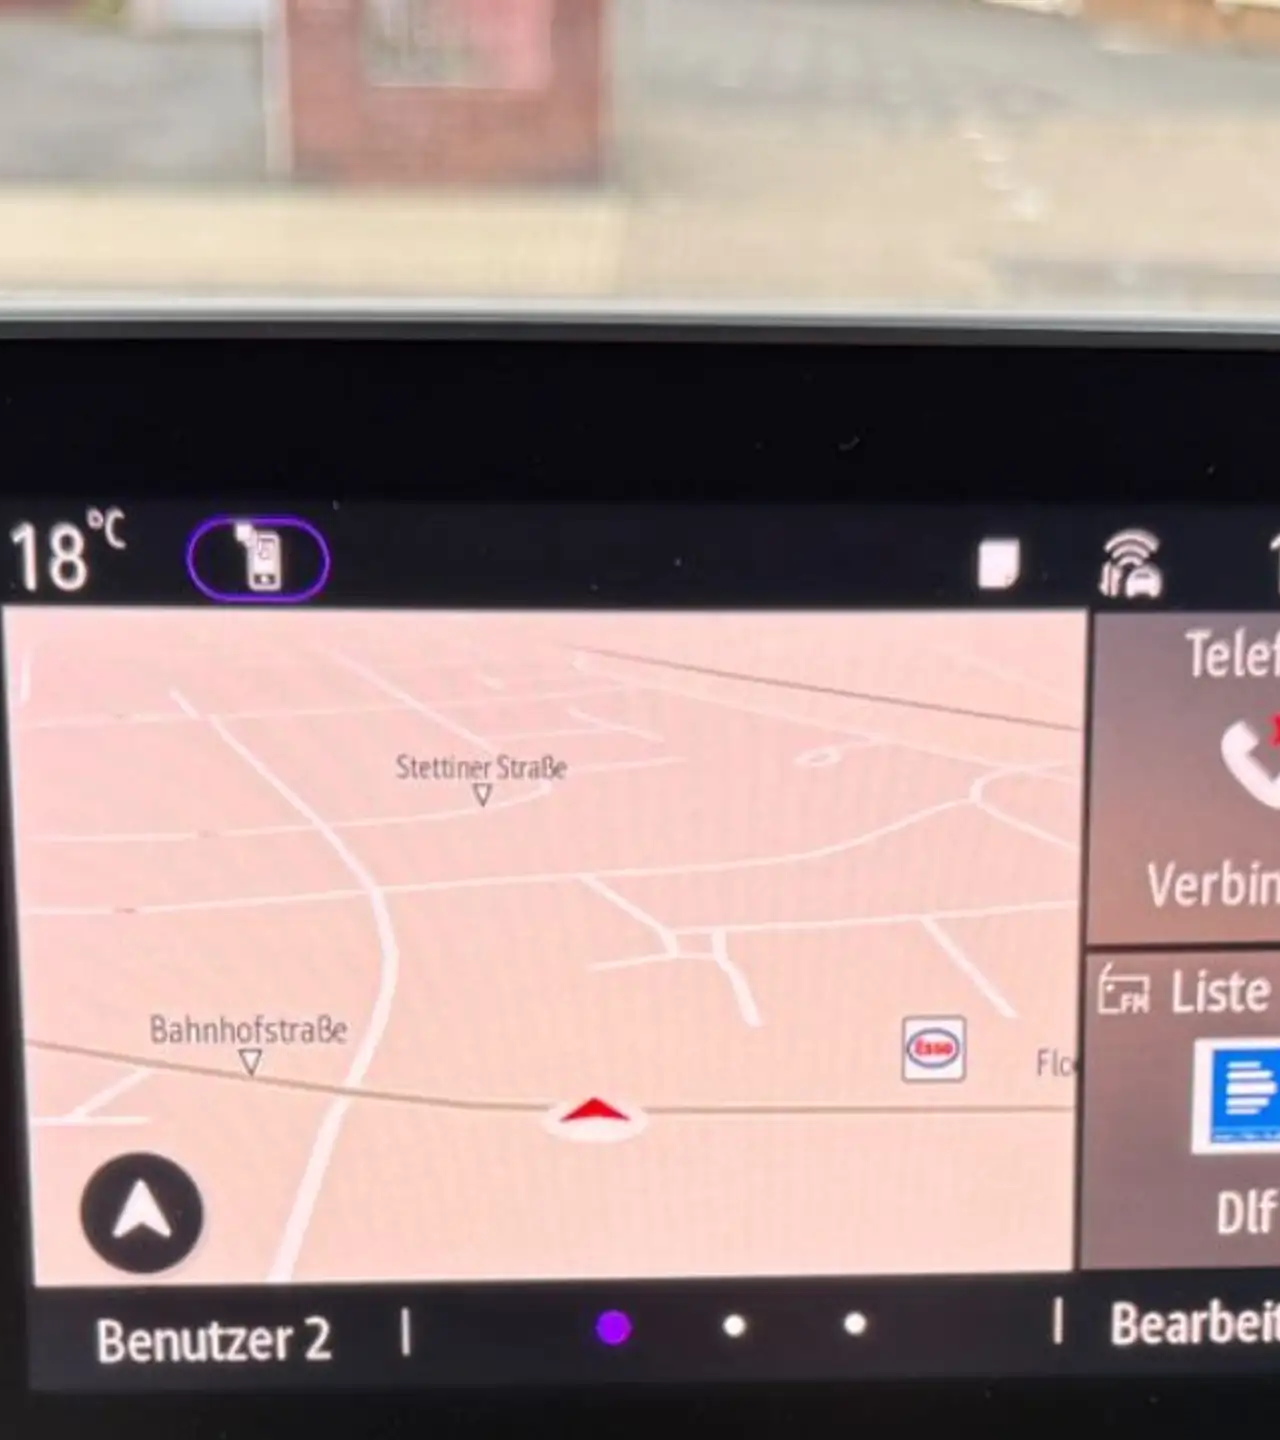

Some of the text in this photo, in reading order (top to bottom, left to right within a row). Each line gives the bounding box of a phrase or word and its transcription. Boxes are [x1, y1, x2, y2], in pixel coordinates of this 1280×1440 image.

[396, 753, 568, 780] Stettiner Straße
[1171, 969, 1272, 1014] Liste
[149, 1013, 348, 1044] Bahnhofstraße
[1217, 1188, 1280, 1235] Dlf
[96, 1315, 333, 1363] Benutzer 2
